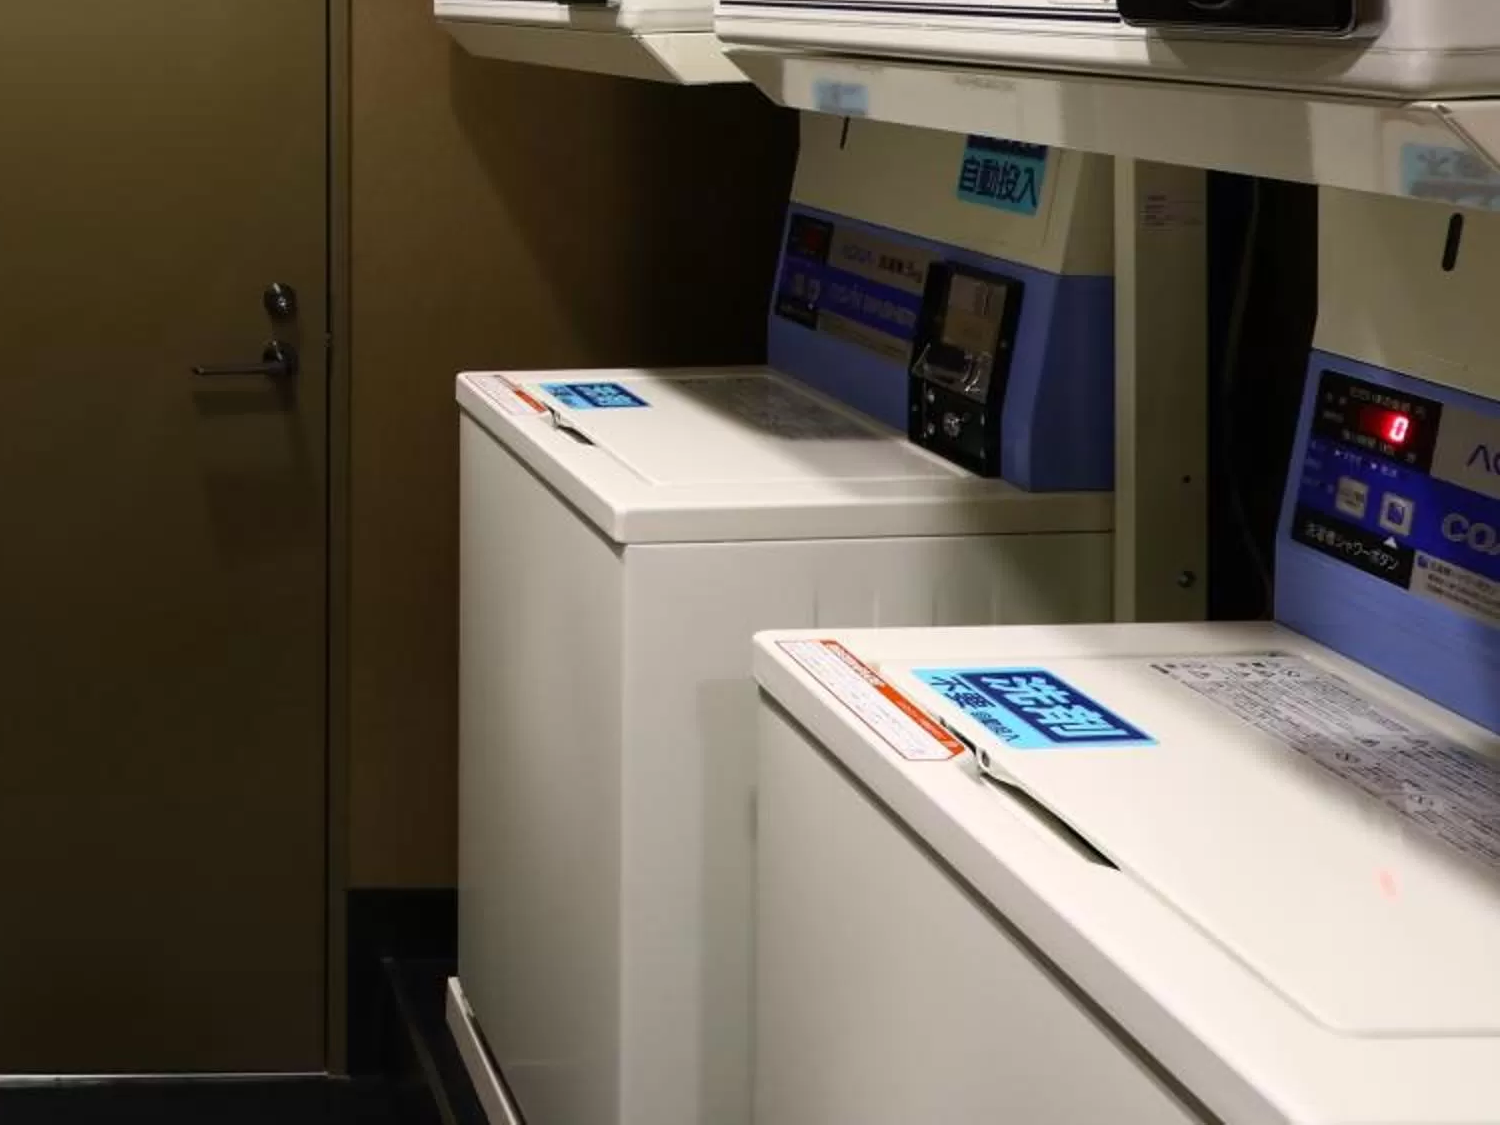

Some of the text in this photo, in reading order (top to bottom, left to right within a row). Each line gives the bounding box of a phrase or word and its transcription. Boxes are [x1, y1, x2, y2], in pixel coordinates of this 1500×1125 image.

[959, 155, 1038, 208] 自動投入
[1389, 416, 1410, 443] 0
[929, 675, 996, 709] 不要
[981, 675, 1130, 738] 洗剤
